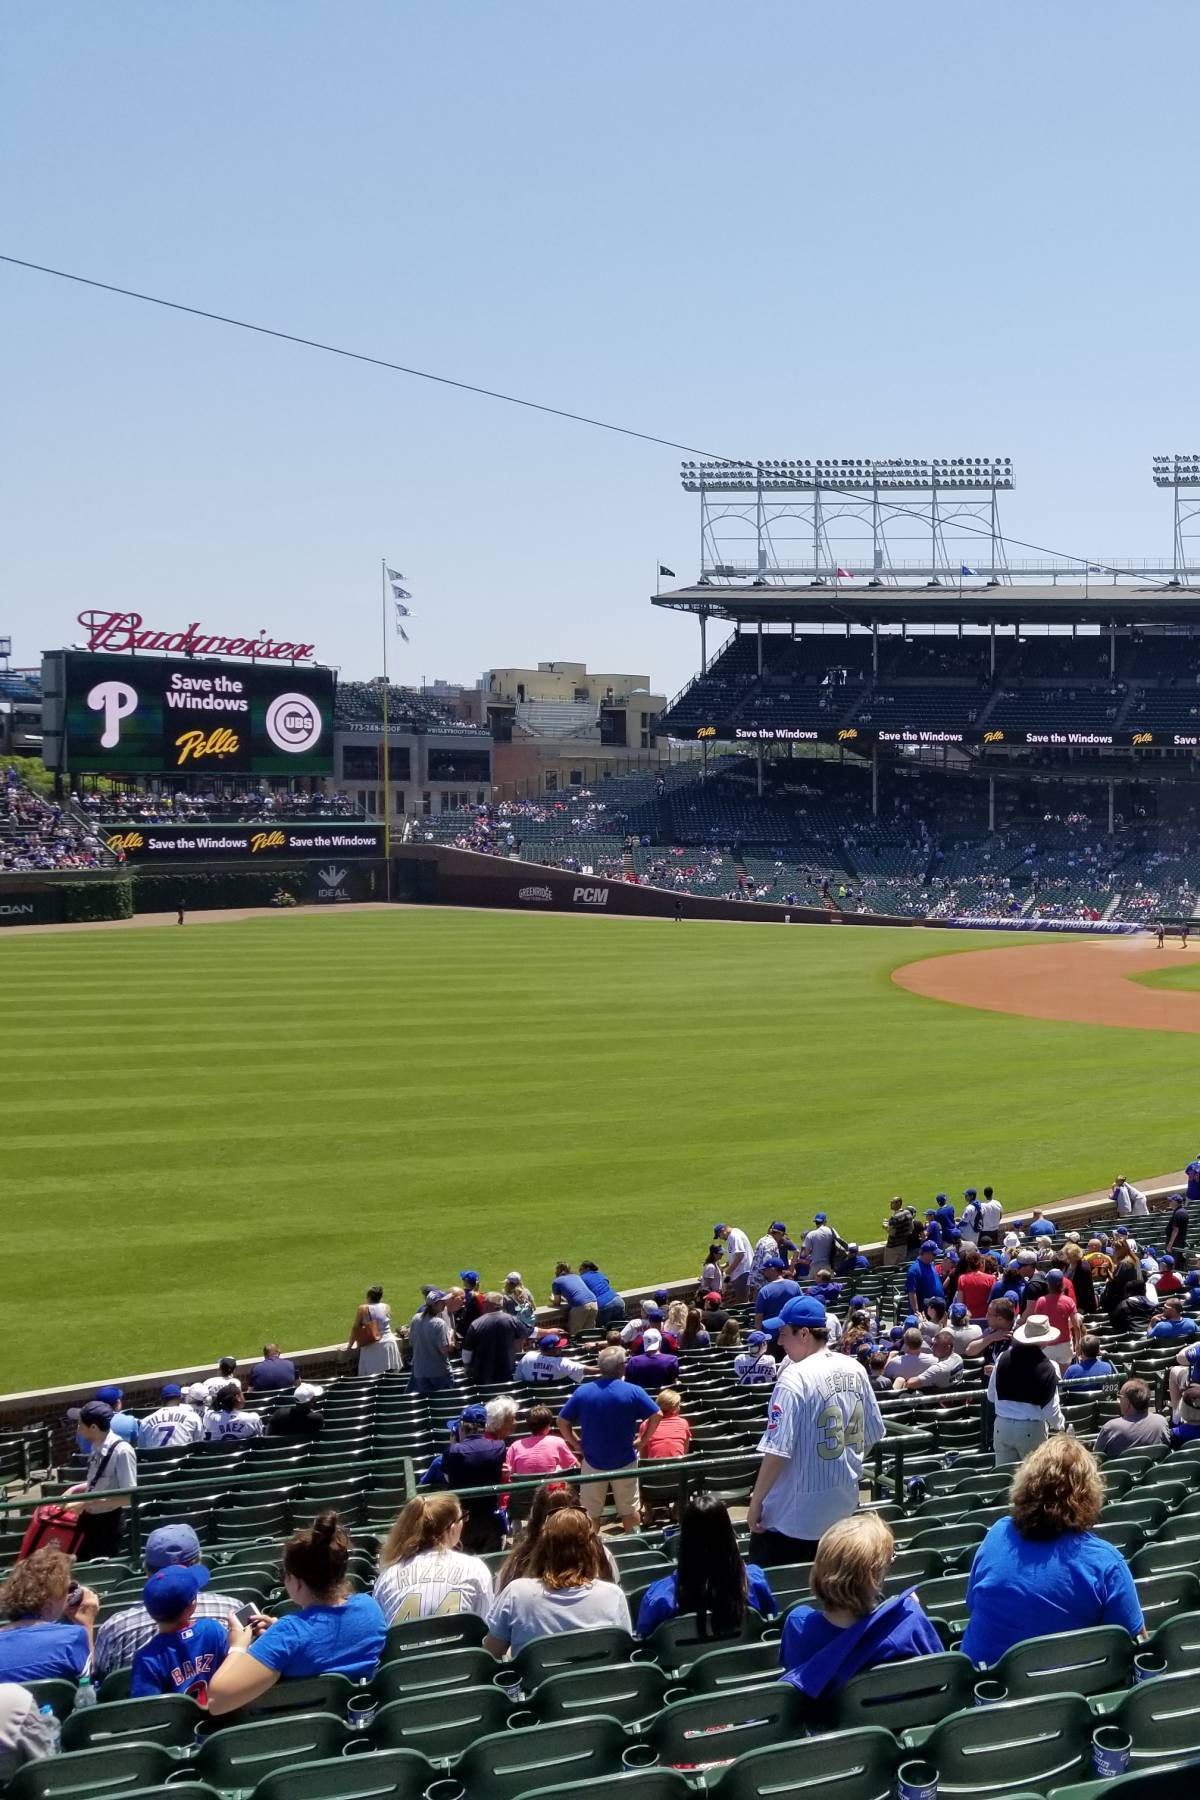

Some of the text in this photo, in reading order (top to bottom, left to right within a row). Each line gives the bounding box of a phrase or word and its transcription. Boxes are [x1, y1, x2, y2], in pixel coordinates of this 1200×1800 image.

[77, 609, 316, 661] Budweiser
[171, 673, 243, 693] Save the
[166, 692, 248, 711] Windows
[696, 727, 818, 739] Pella Save the Windows
[837, 729, 963, 742] Pella Save the Windows
[983, 731, 1113, 744] Pella Save the Windows
[1132, 733, 1153, 746] Pella
[1173, 735, 1197, 745] Save
[175, 727, 240, 765] Pella
[107, 831, 376, 852] Pella Save the Windows Pella Save the Windows
[318, 888, 349, 897] IDEAL
[572, 887, 609, 903] PCM
[999, 919, 1025, 929] Wrap
[1047, 918, 1091, 930] Reynolds
[1092, 920, 1120, 932] Wrap
[816, 1373, 861, 1401] LESTER
[158, 1425, 176, 1446] 7
[219, 1422, 246, 1434] BAEZ
[816, 1400, 865, 1460] 34
[397, 1563, 464, 1591] RIZZO
[171, 1654, 215, 1687] BAEZ
